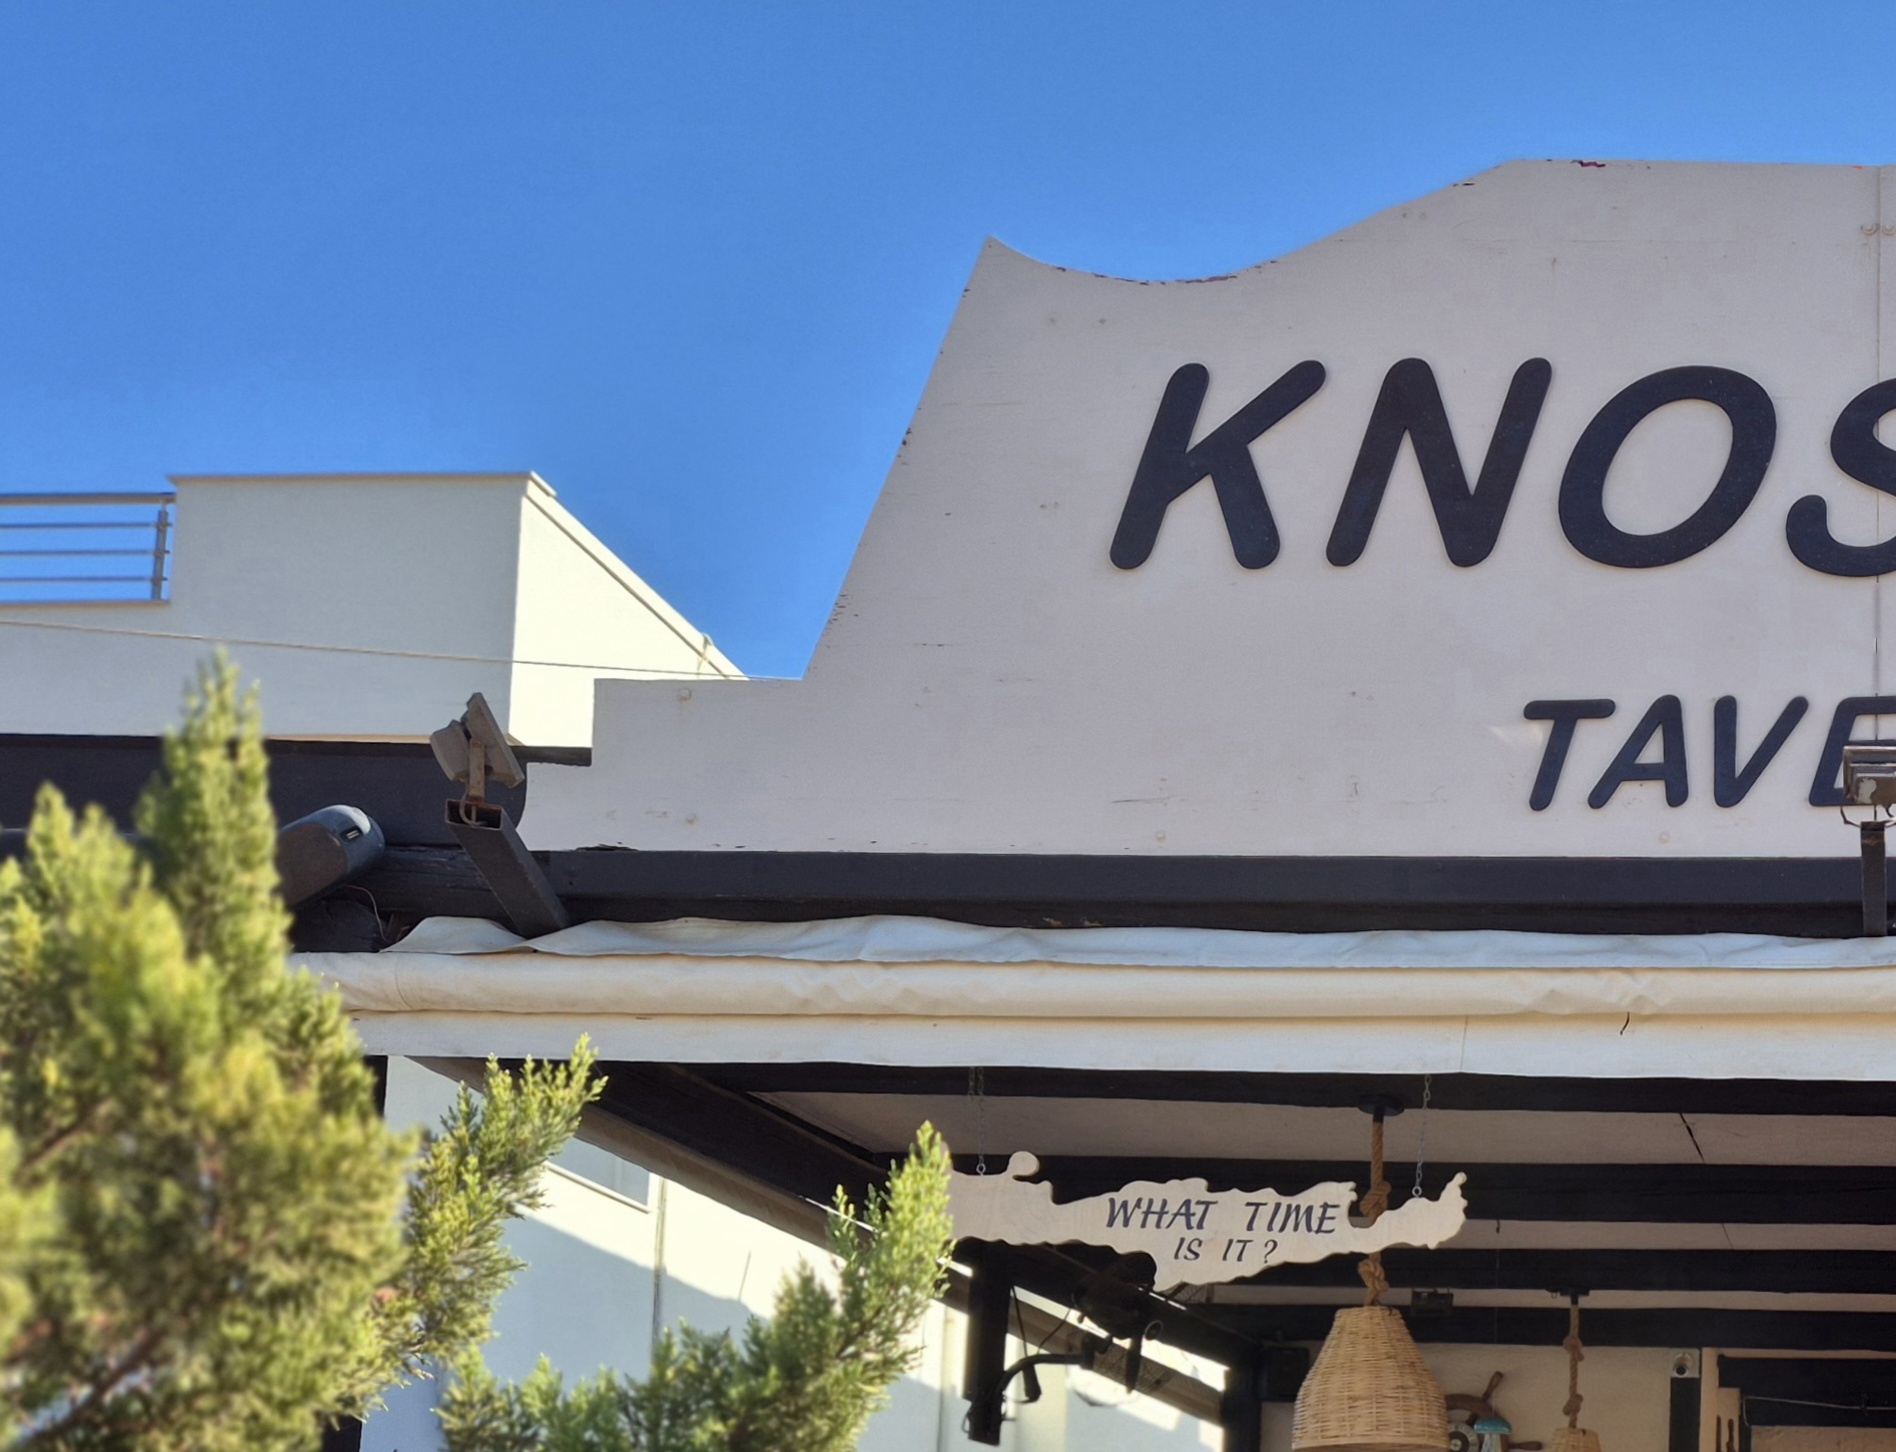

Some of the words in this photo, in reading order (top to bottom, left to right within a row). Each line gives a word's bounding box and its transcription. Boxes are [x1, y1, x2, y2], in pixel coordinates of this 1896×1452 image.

[1105, 1196, 1219, 1231] WHAT
[1244, 1201, 1342, 1235] TIME
[1173, 1237, 1203, 1261] IS
